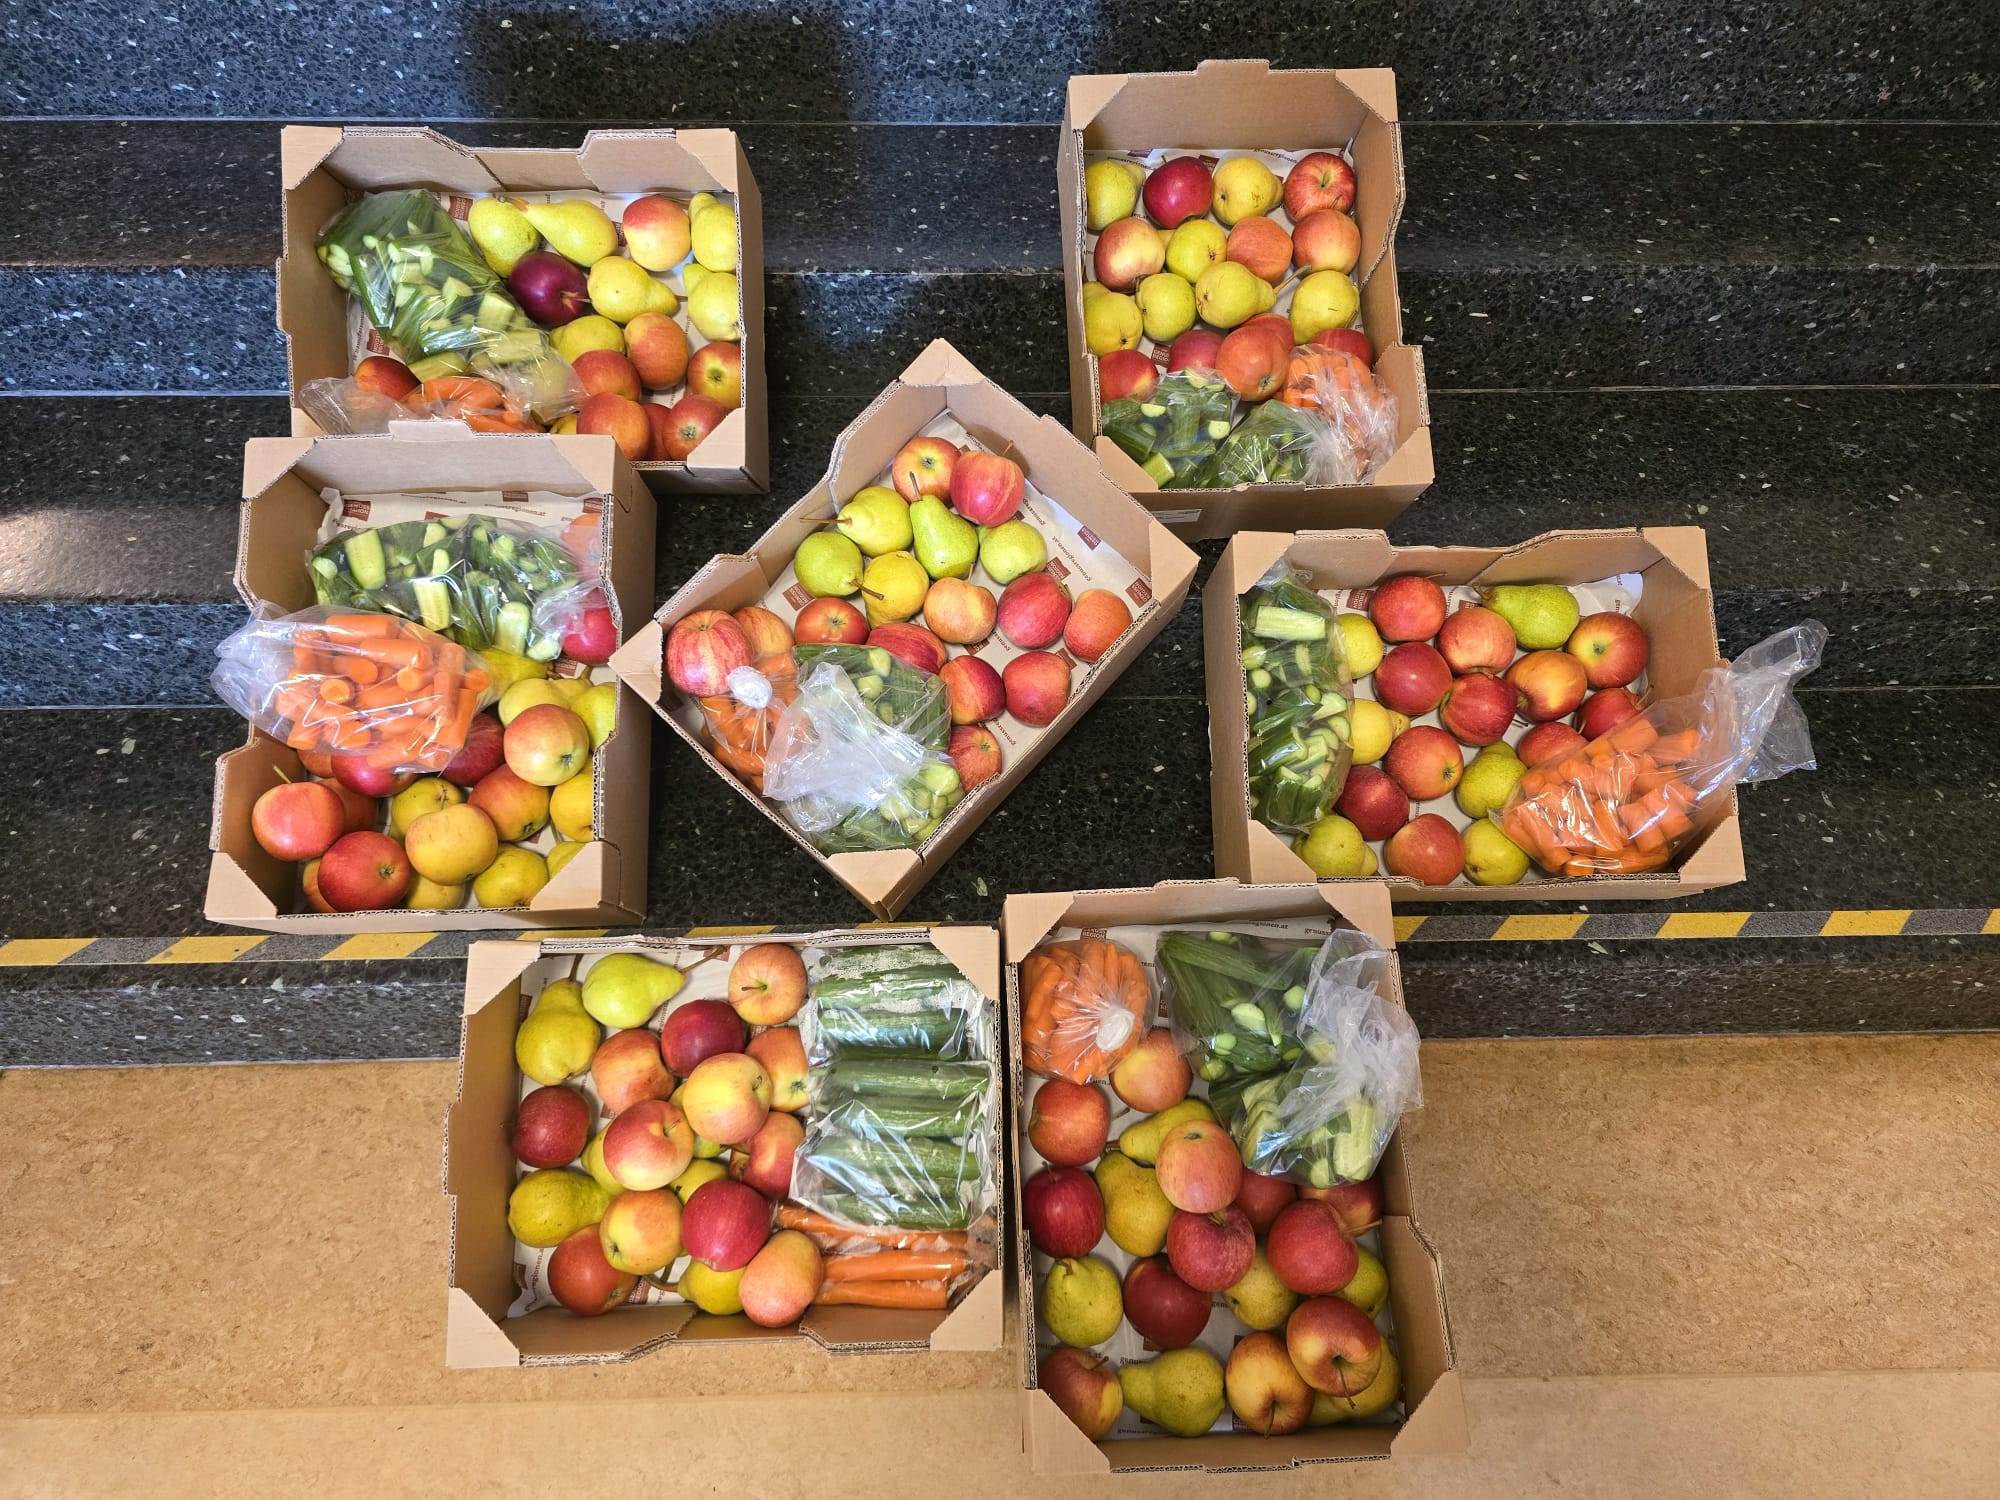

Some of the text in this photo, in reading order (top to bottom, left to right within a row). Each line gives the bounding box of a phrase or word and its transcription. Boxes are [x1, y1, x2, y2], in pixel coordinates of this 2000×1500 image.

[1051, 536, 1094, 582] genussregionen.at
[790, 588, 805, 606] GENUSS
[1082, 930, 1106, 939] REGION
